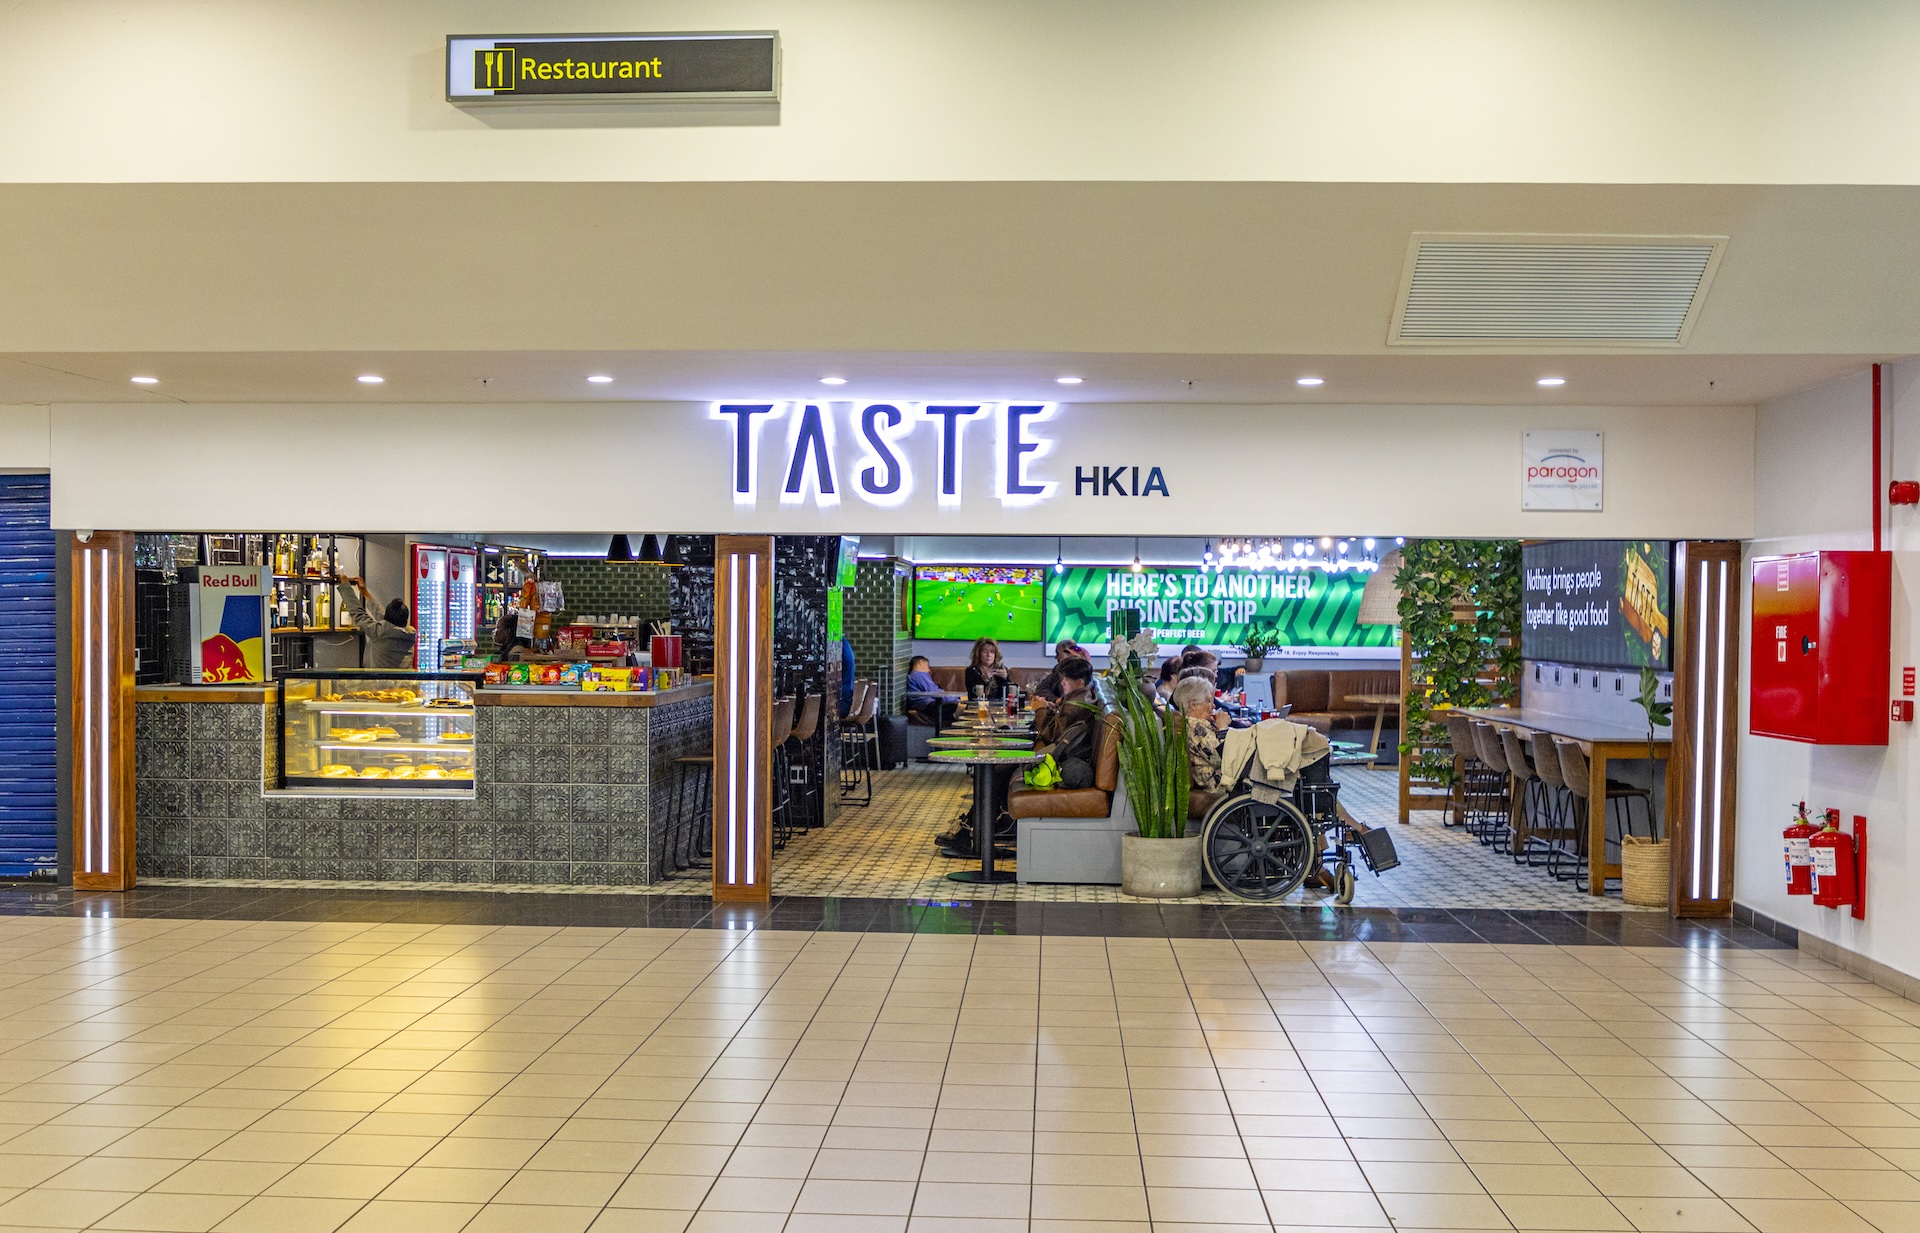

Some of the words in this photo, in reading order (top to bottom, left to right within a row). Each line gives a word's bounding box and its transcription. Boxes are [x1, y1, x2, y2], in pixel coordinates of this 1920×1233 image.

[521, 57, 663, 80] Restaurant
[719, 404, 1047, 495] TASTE
[1075, 466, 1170, 497] HKIA
[1528, 466, 1598, 483] paragon
[203, 574, 229, 587] Red
[232, 574, 257, 587] Bull
[1106, 573, 1178, 598] HERE'S
[1182, 573, 1209, 598] TO
[1211, 574, 1311, 599] ANOTHER
[1526, 567, 1552, 596] Nothing
[1553, 566, 1575, 596] brings
[1576, 563, 1602, 595] people
[1210, 600, 1257, 624] TRIP
[1526, 602, 1555, 630] together
[1556, 602, 1568, 626] like
[1569, 601, 1589, 632] good
[1590, 600, 1609, 626] food
[1157, 629, 1187, 638] PERFECT
[1187, 629, 1205, 638] BEER
[1775, 625, 1788, 639] FIRE
